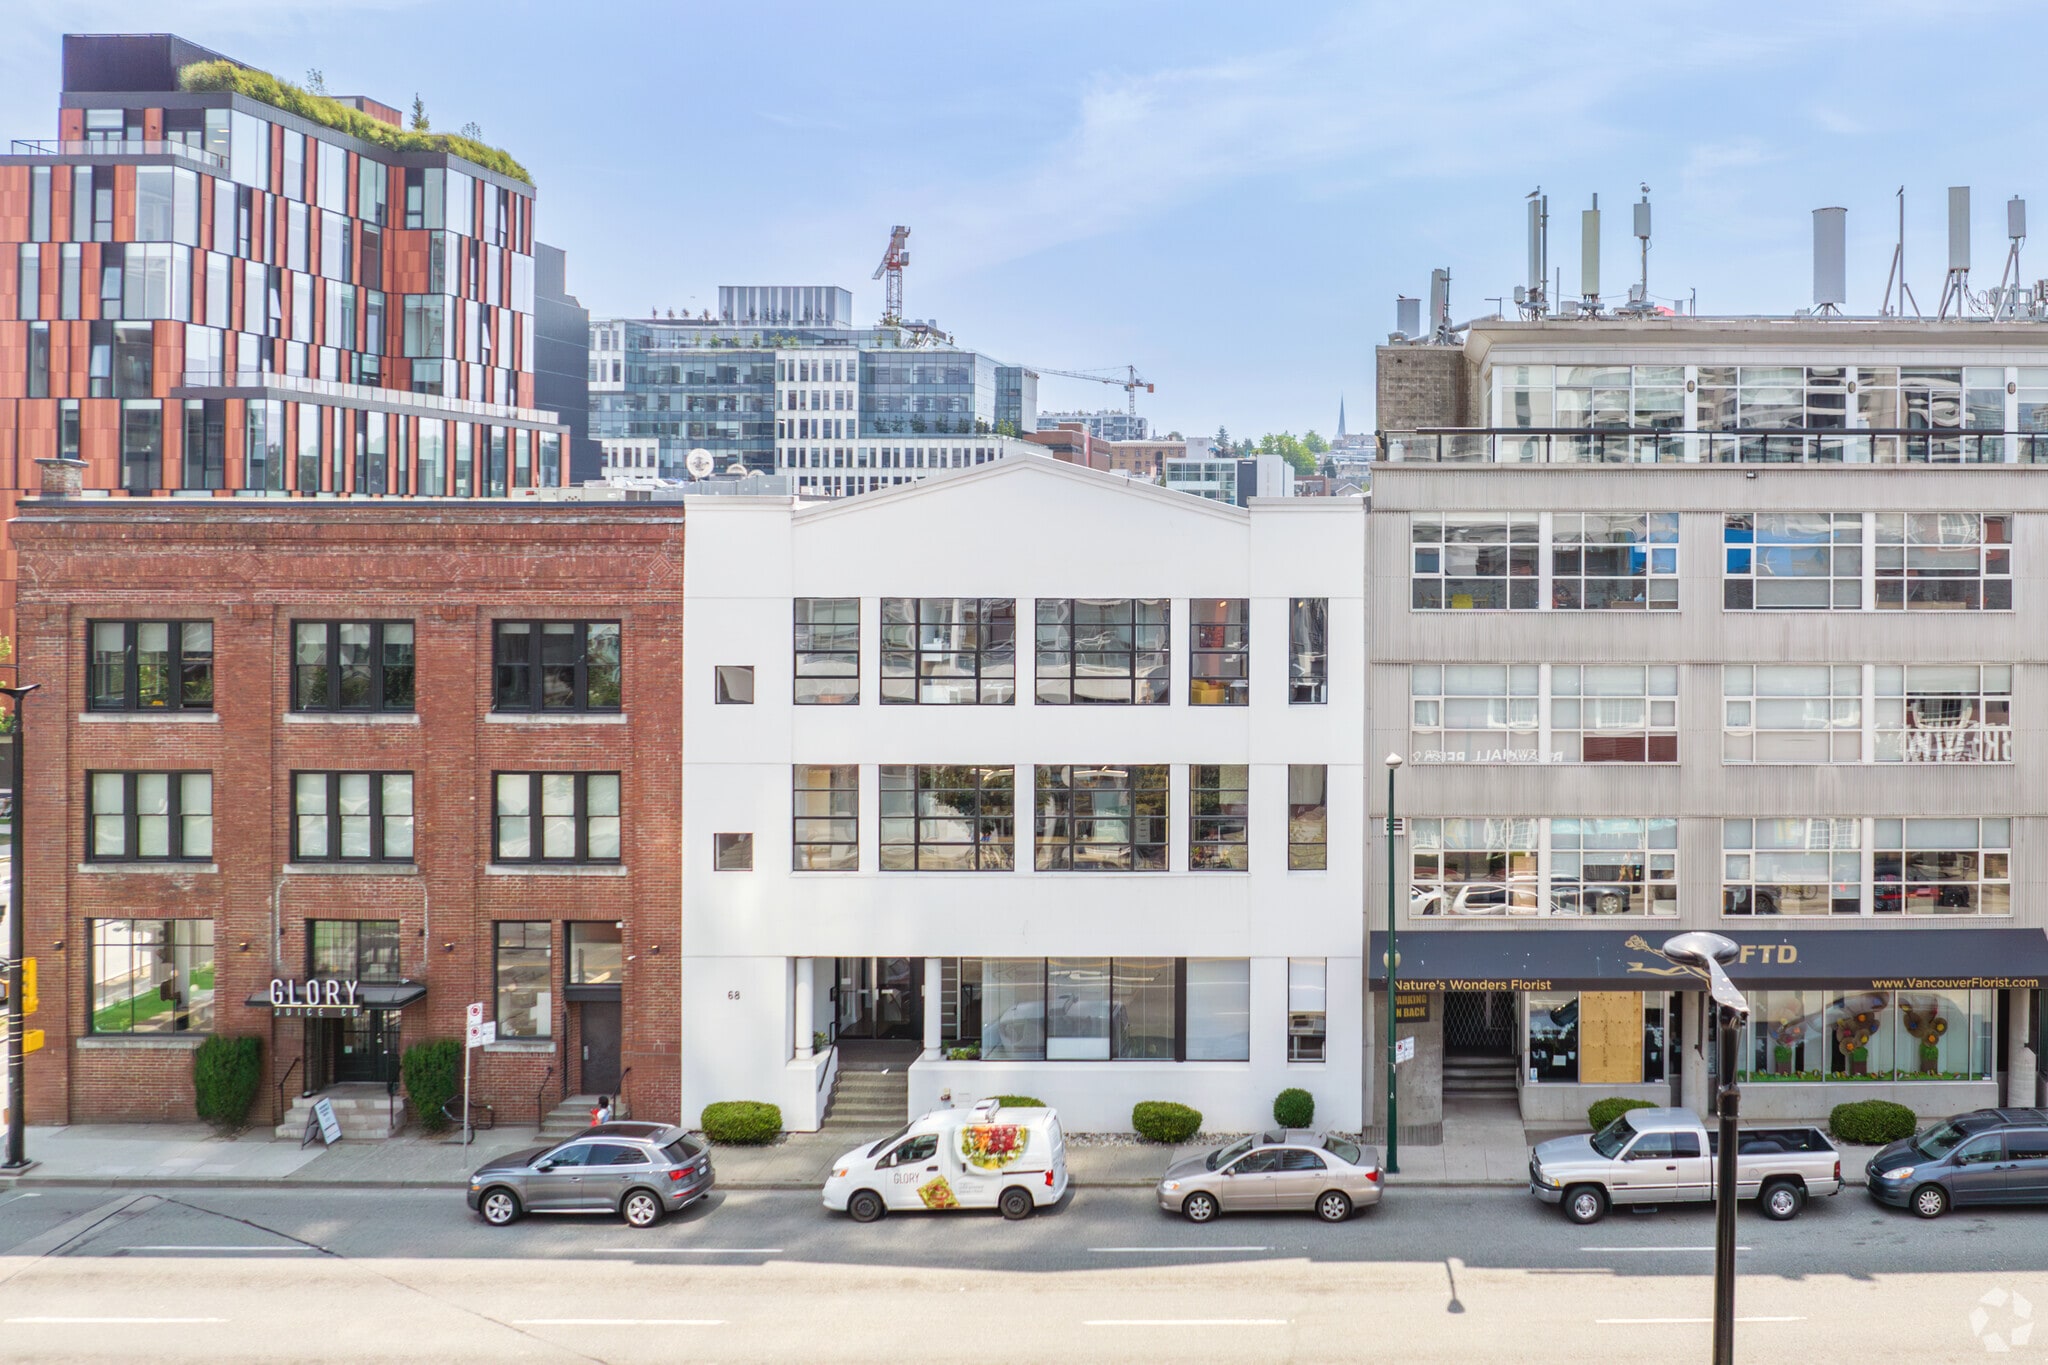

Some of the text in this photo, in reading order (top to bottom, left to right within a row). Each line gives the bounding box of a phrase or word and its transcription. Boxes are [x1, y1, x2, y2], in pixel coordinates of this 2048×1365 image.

[1739, 944, 1798, 964] FTD
[1395, 979, 1552, 990] Nature's Wonders Florist
[1872, 977, 2039, 989] www.VancouverFlorist.com
[270, 978, 358, 1006] GLORY
[727, 990, 740, 1000] 68
[1396, 994, 1427, 1005] ARKING
[274, 1007, 324, 1017] JUICE
[1404, 1006, 1426, 1018] BACK
[893, 1172, 920, 1185] GLORY
